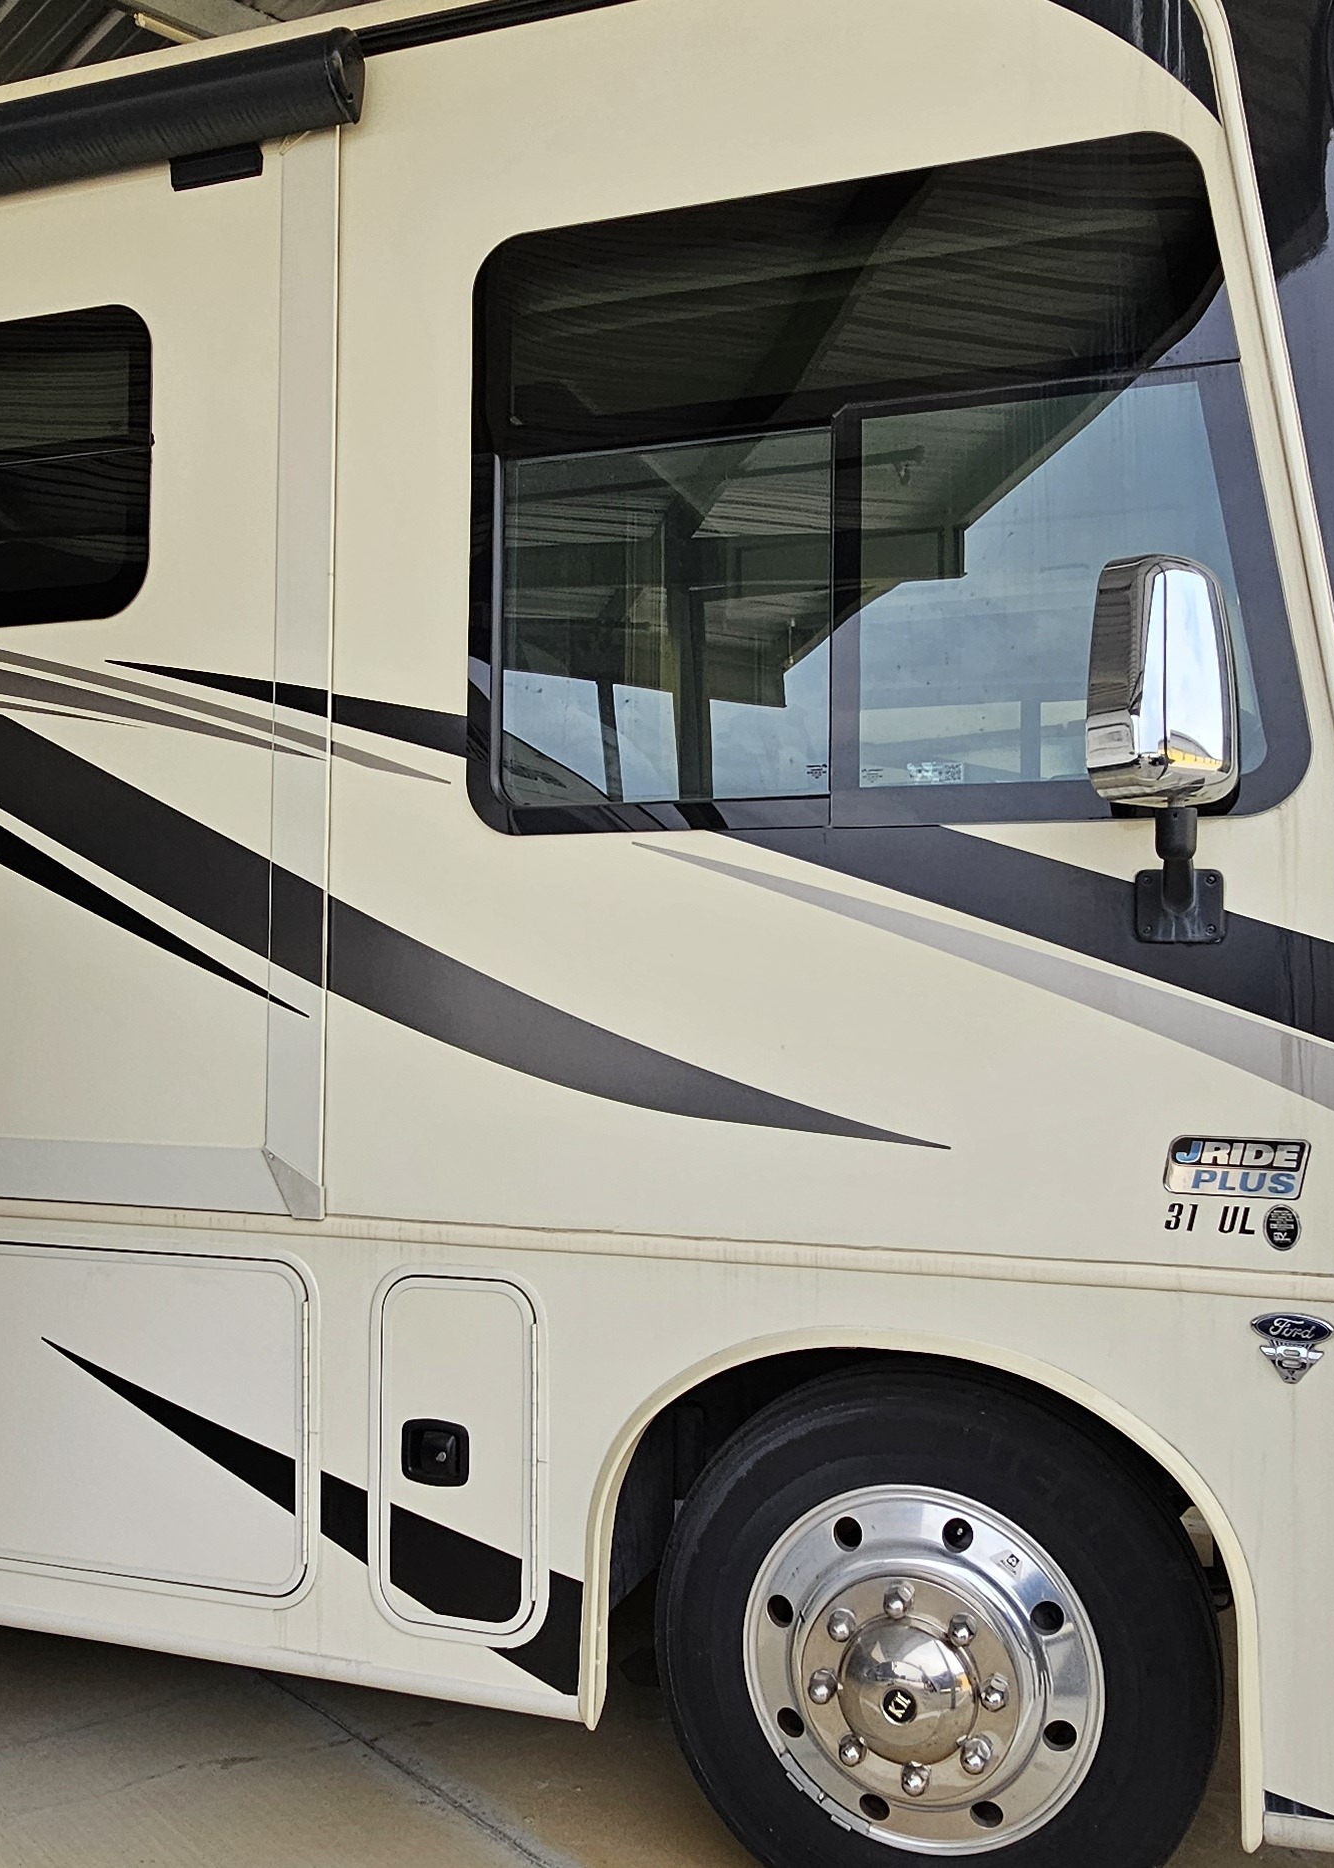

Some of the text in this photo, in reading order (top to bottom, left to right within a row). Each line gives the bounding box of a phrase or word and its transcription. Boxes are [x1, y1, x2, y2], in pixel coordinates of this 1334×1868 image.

[1175, 1140, 1300, 1168] JRIDE
[1191, 1169, 1296, 1194] PLUS
[1164, 1203, 1198, 1231] 31
[1218, 1206, 1255, 1235] UL
[1269, 1317, 1316, 1339] Ford
